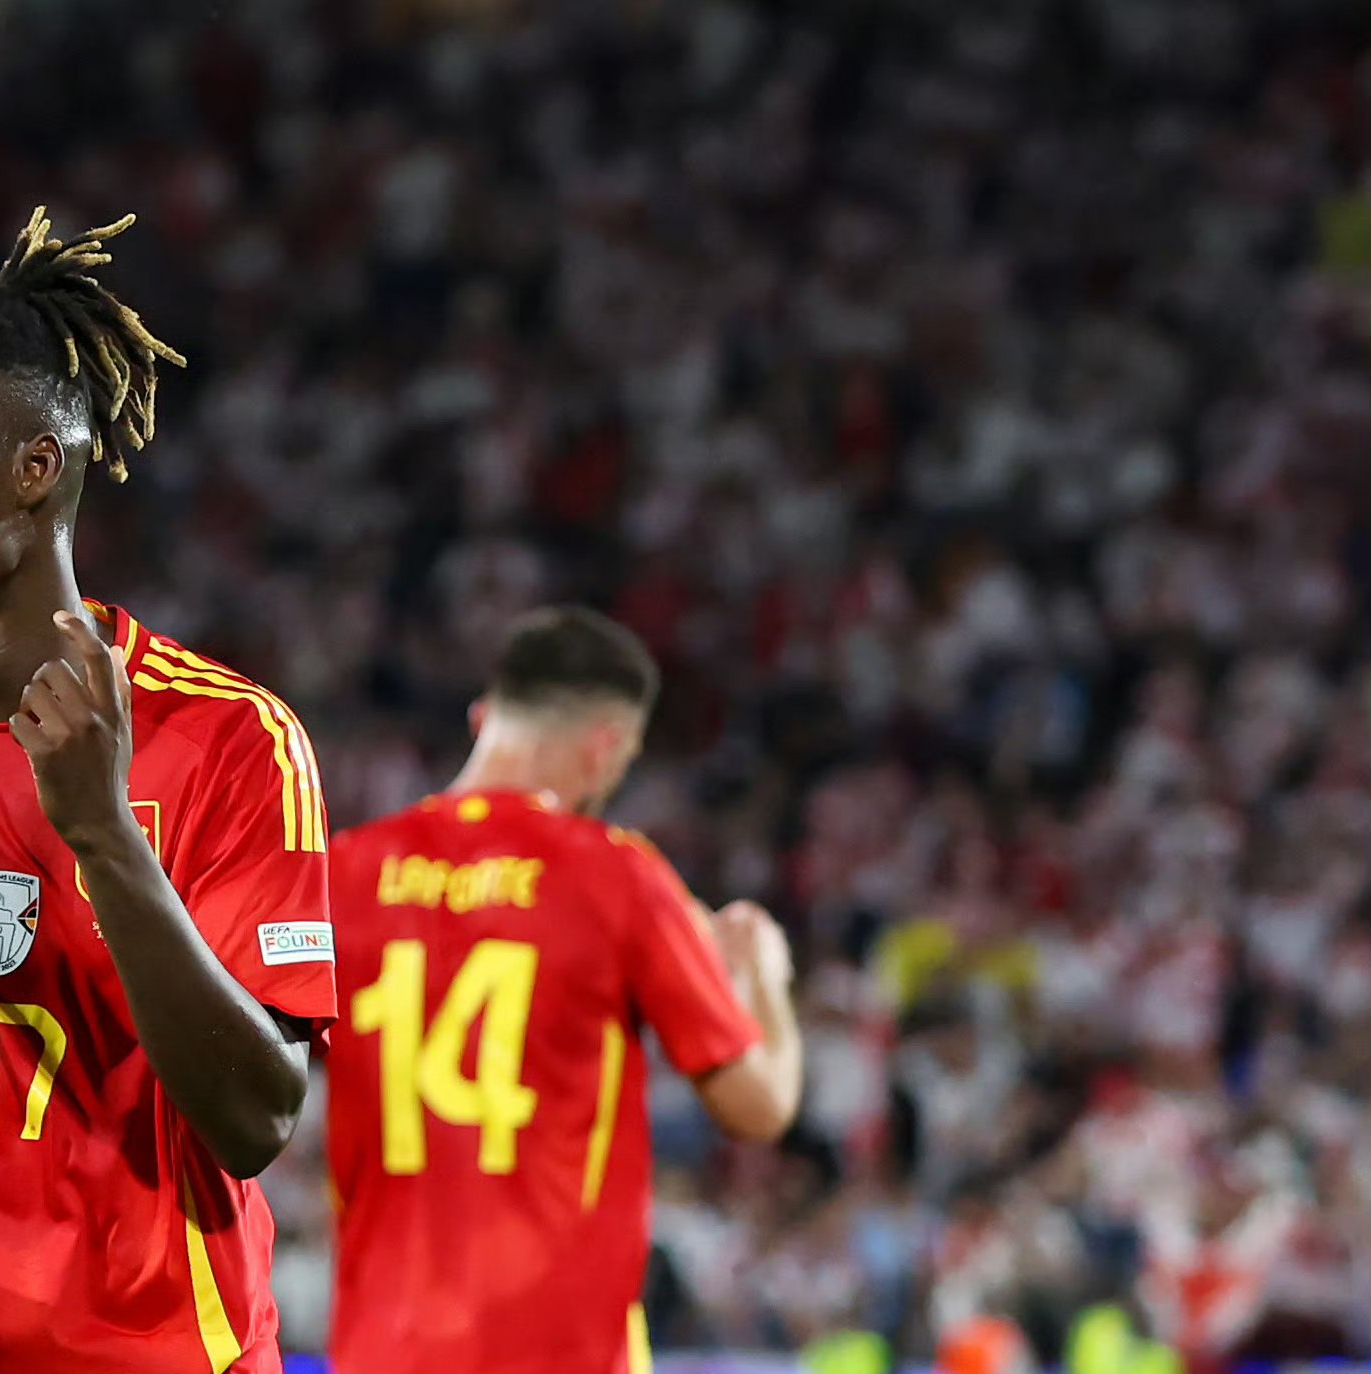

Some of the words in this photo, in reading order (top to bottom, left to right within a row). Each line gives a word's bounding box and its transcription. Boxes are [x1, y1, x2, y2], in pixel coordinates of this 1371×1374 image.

[8, 875, 34, 885] LEAGUE
[263, 925, 290, 935] UEFA
[350, 937, 540, 1176] 14
